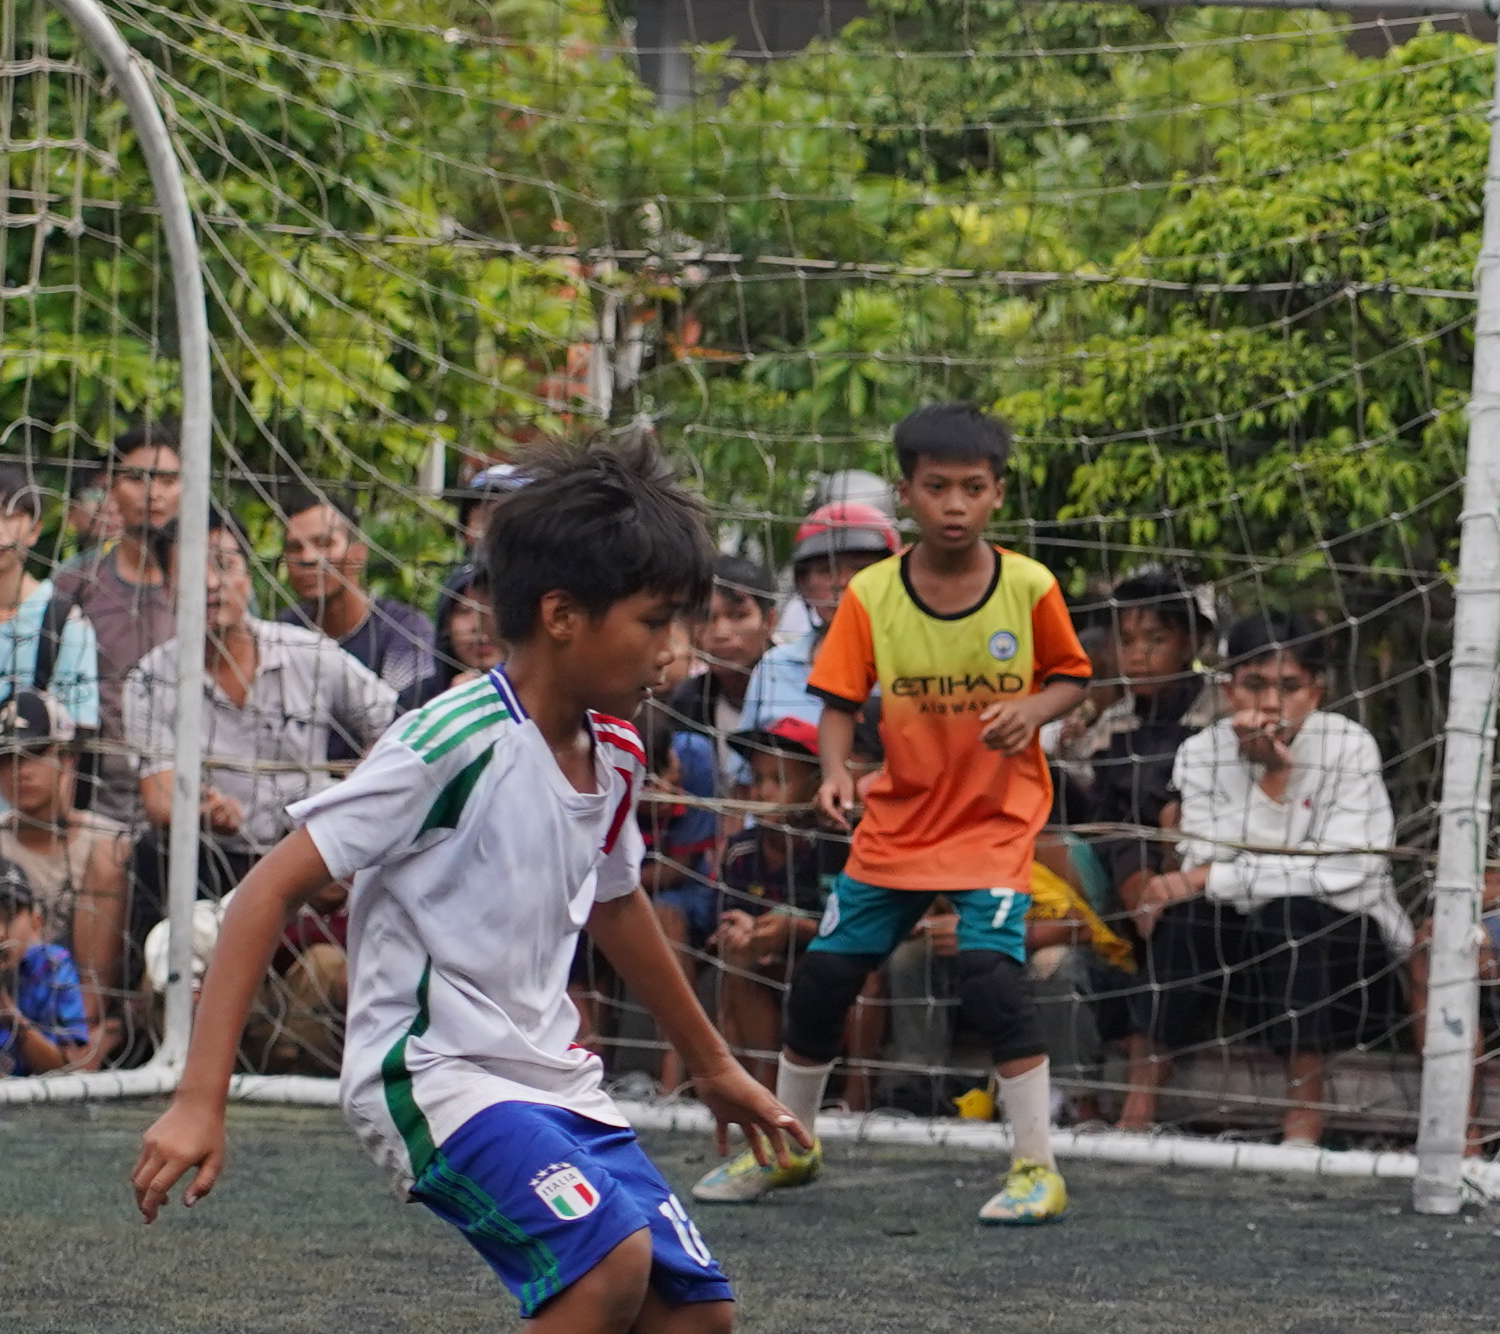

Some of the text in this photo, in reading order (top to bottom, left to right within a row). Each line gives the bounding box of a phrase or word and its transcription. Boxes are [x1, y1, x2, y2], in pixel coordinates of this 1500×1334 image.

[891, 672, 1024, 697] ETIHAD
[919, 699, 989, 715] AIRWAY
[989, 887, 1015, 929] 7
[541, 1172, 578, 1197] ITALIA
